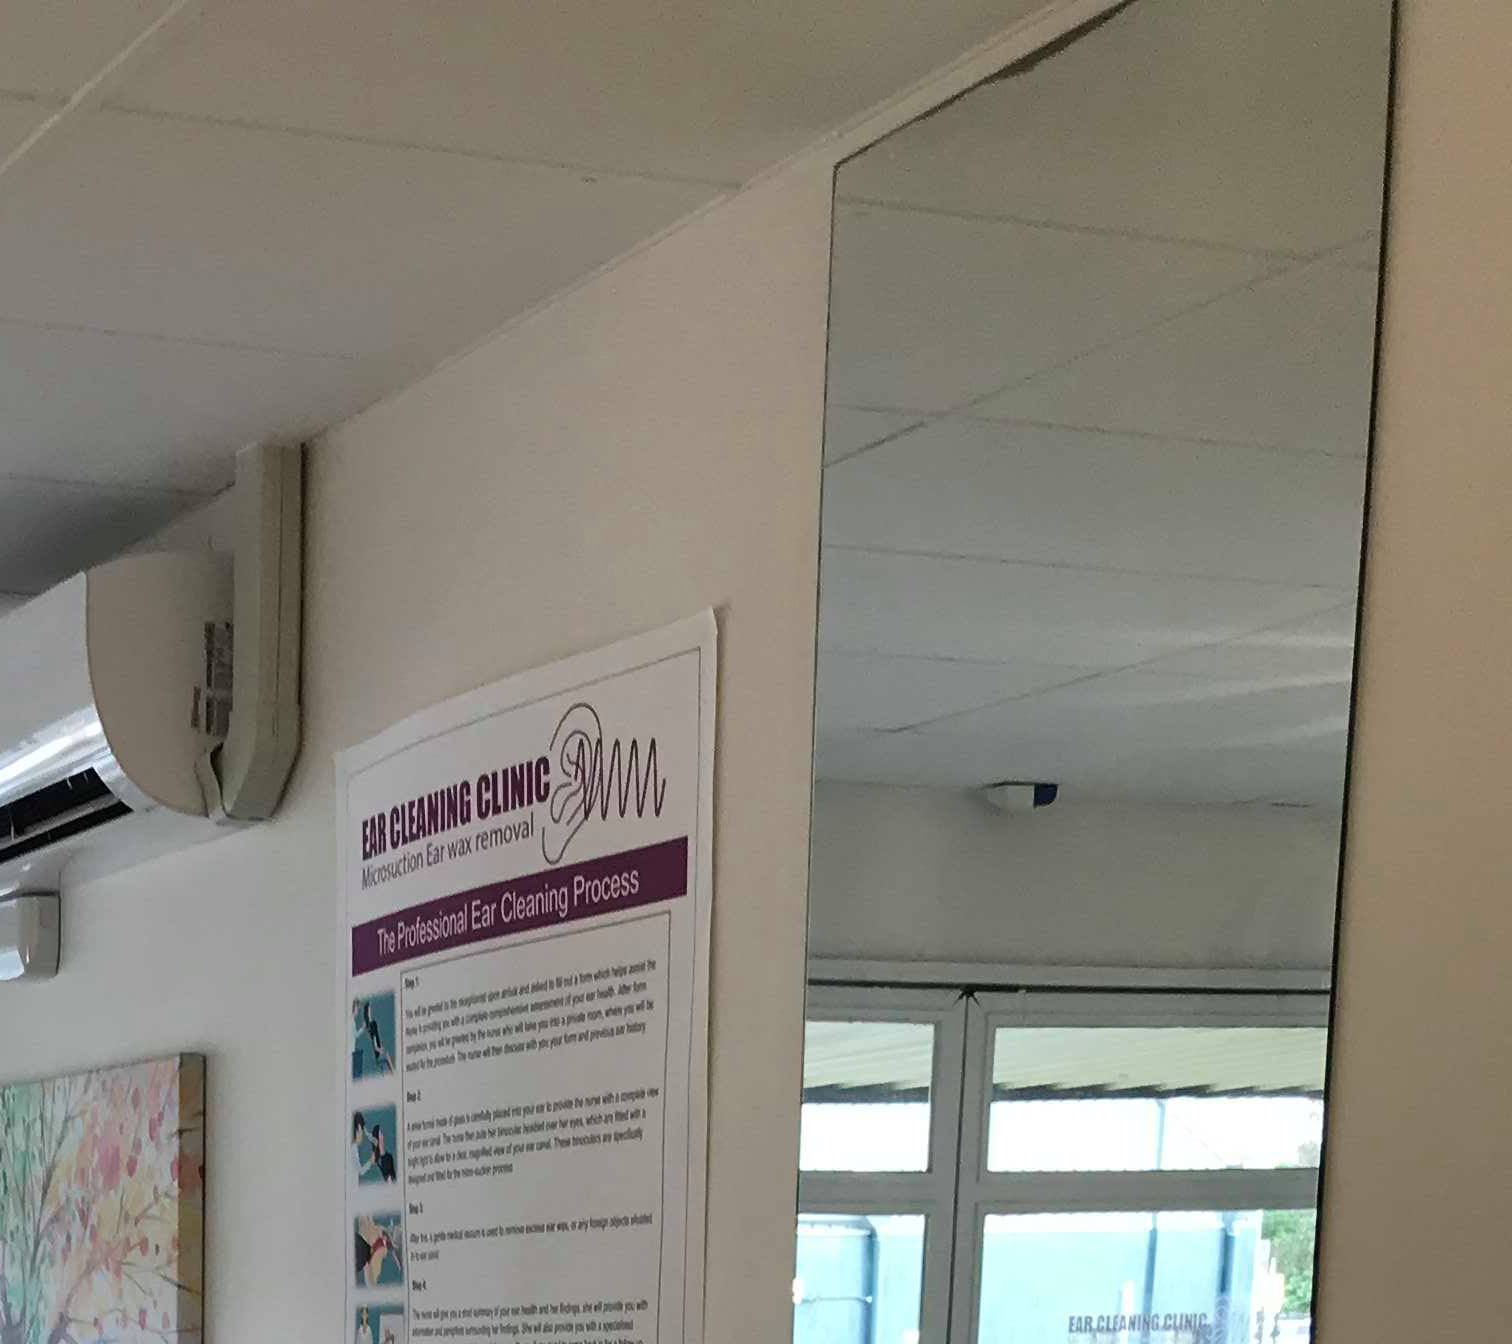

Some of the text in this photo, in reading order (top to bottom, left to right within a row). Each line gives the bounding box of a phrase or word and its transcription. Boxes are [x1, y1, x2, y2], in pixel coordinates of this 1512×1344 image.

[362, 756, 550, 861] EAR CLEANING CLINIC
[362, 811, 533, 890] Microsuction Ear wax removal
[377, 870, 639, 955] The Professional Ear Cleaning Process
[1069, 1313, 1208, 1333] EAR CLEANING CLINIC
